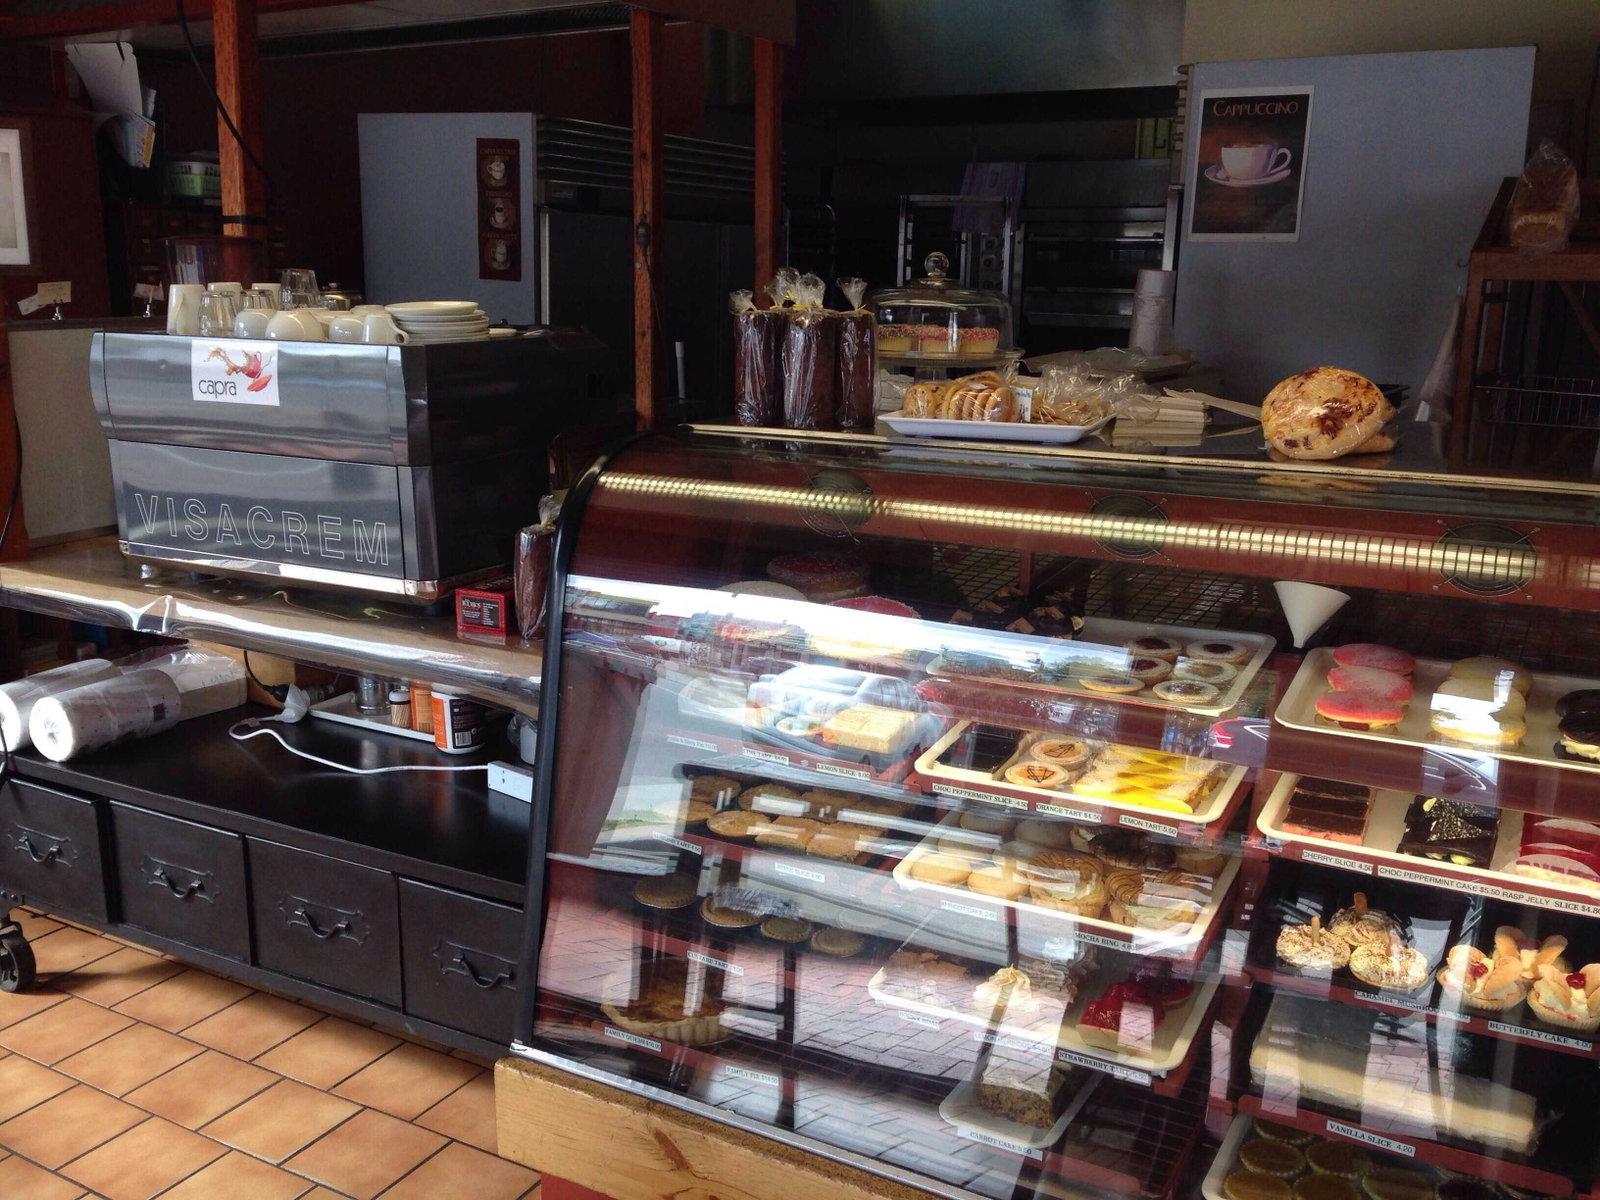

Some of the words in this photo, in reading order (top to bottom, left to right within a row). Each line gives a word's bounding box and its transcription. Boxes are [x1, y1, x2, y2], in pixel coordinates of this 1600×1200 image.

[1212, 100, 1299, 117] CAPPUCCINO
[198, 379, 237, 399] capra
[134, 493, 389, 566] VISACREM
[817, 764, 838, 773] LEMON
[838, 767, 856, 776] SLICE
[933, 784, 952, 793] CHOC
[952, 787, 993, 800] PEPPERMINT
[994, 795, 1013, 805] SLICE
[1036, 803, 1062, 814] ORANGE
[1063, 808, 1082, 818] TART
[1120, 815, 1144, 827] LEMON
[1144, 820, 1162, 831] TART
[1162, 825, 1177, 834] 5.50
[1302, 851, 1333, 863] CHERRY
[1334, 858, 1356, 868] SLICE
[1357, 863, 1372, 872] 4.50
[1379, 866, 1402, 877] CHOC
[1403, 871, 1455, 887] PEPPERMINT
[1456, 880, 1478, 892] CAKE
[1479, 886, 1501, 897] $5.50
[1502, 891, 1525, 901] RASP
[1525, 896, 1551, 906] JELLY
[1554, 901, 1580, 911] SLICE
[1075, 931, 1100, 943] MOCHA
[1101, 937, 1119, 947] RING
[687, 951, 714, 964] CUSTARD
[1355, 990, 1395, 1004] CARAMEL
[606, 1028, 625, 1038] FAMILY
[1489, 1022, 1543, 1038] BUTTERFLY
[1543, 1033, 1569, 1044] CAKE
[1574, 1040, 1592, 1049] 4.00
[1059, 1051, 1107, 1069] STRAWBERRY
[727, 1066, 749, 1077] FAMILY
[969, 1131, 997, 1143] CARROT
[998, 1139, 1016, 1149] CAKE
[1329, 1122, 1365, 1139] VANILLA
[1367, 1134, 1391, 1148] SLICE
[1396, 1144, 1413, 1153] 4.20
